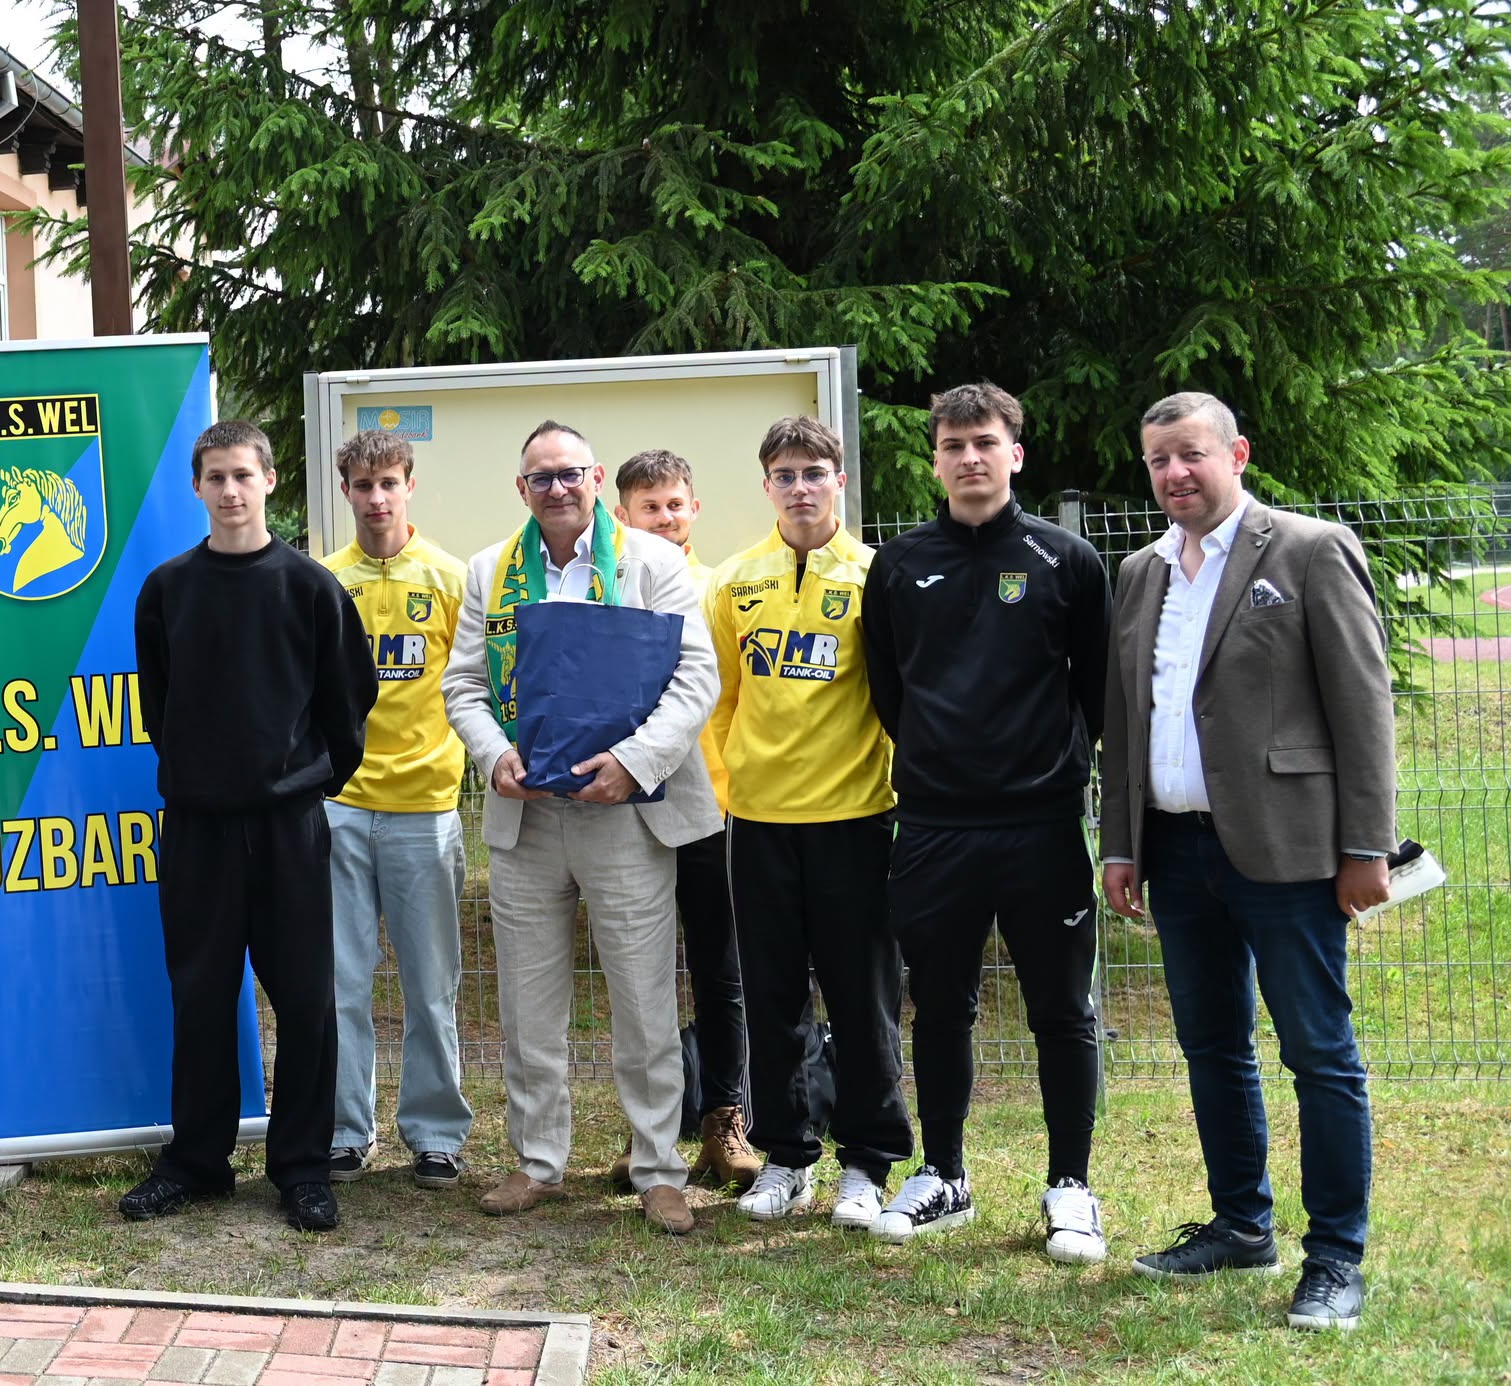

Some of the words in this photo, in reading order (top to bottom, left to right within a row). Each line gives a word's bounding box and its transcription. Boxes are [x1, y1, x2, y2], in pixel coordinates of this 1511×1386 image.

[37, 400, 95, 433] WEL
[1023, 534, 1061, 568] Sarnowski
[731, 580, 779, 597] SARNOWSKI
[486, 619, 516, 634] L.K.S.
[377, 633, 426, 665] MR
[782, 630, 839, 668] MR
[782, 667, 832, 679] TANK-OIL
